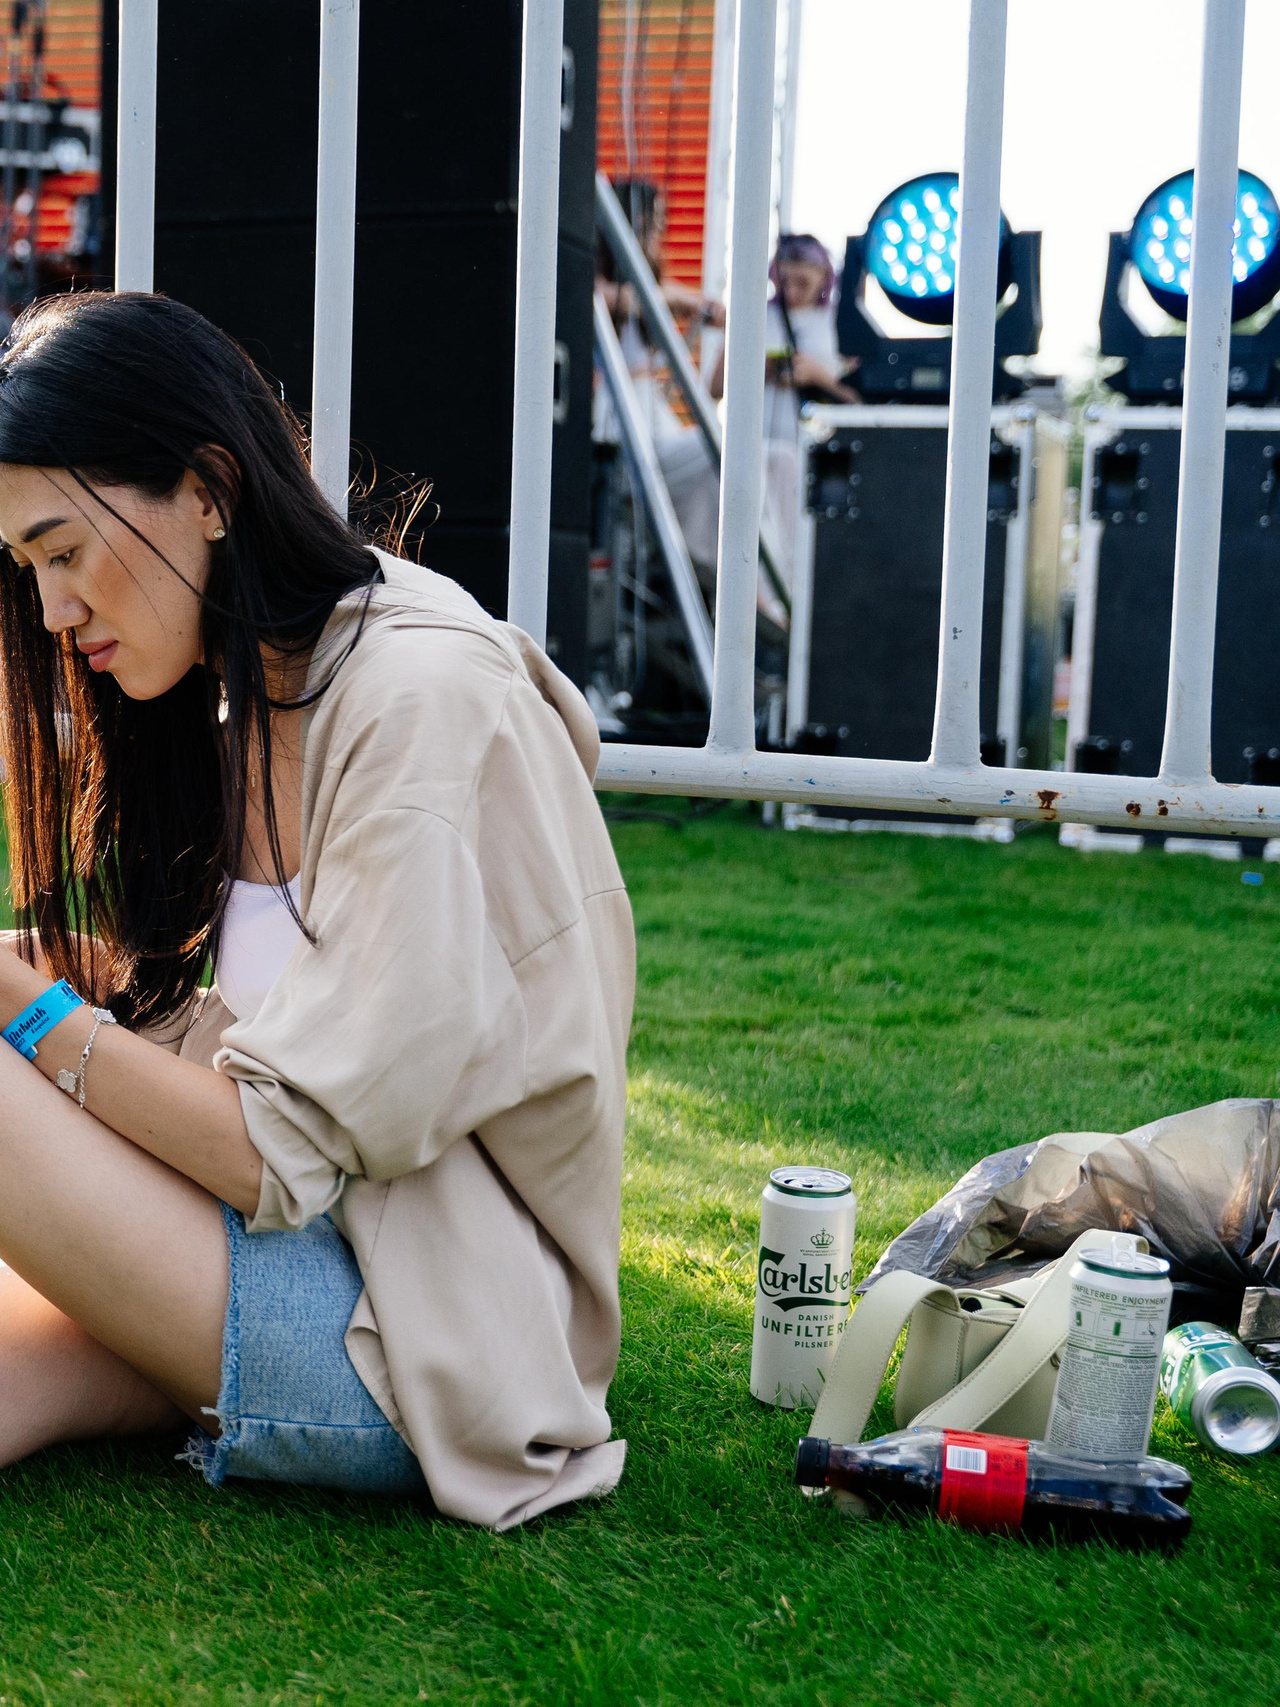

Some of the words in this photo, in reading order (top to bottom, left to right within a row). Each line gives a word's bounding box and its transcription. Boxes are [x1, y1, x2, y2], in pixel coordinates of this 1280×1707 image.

[1071, 1283, 1118, 1301] UNFILTERED
[1122, 1295, 1168, 1306] ENJOYMENT
[794, 1340, 834, 1349] PILSNER
